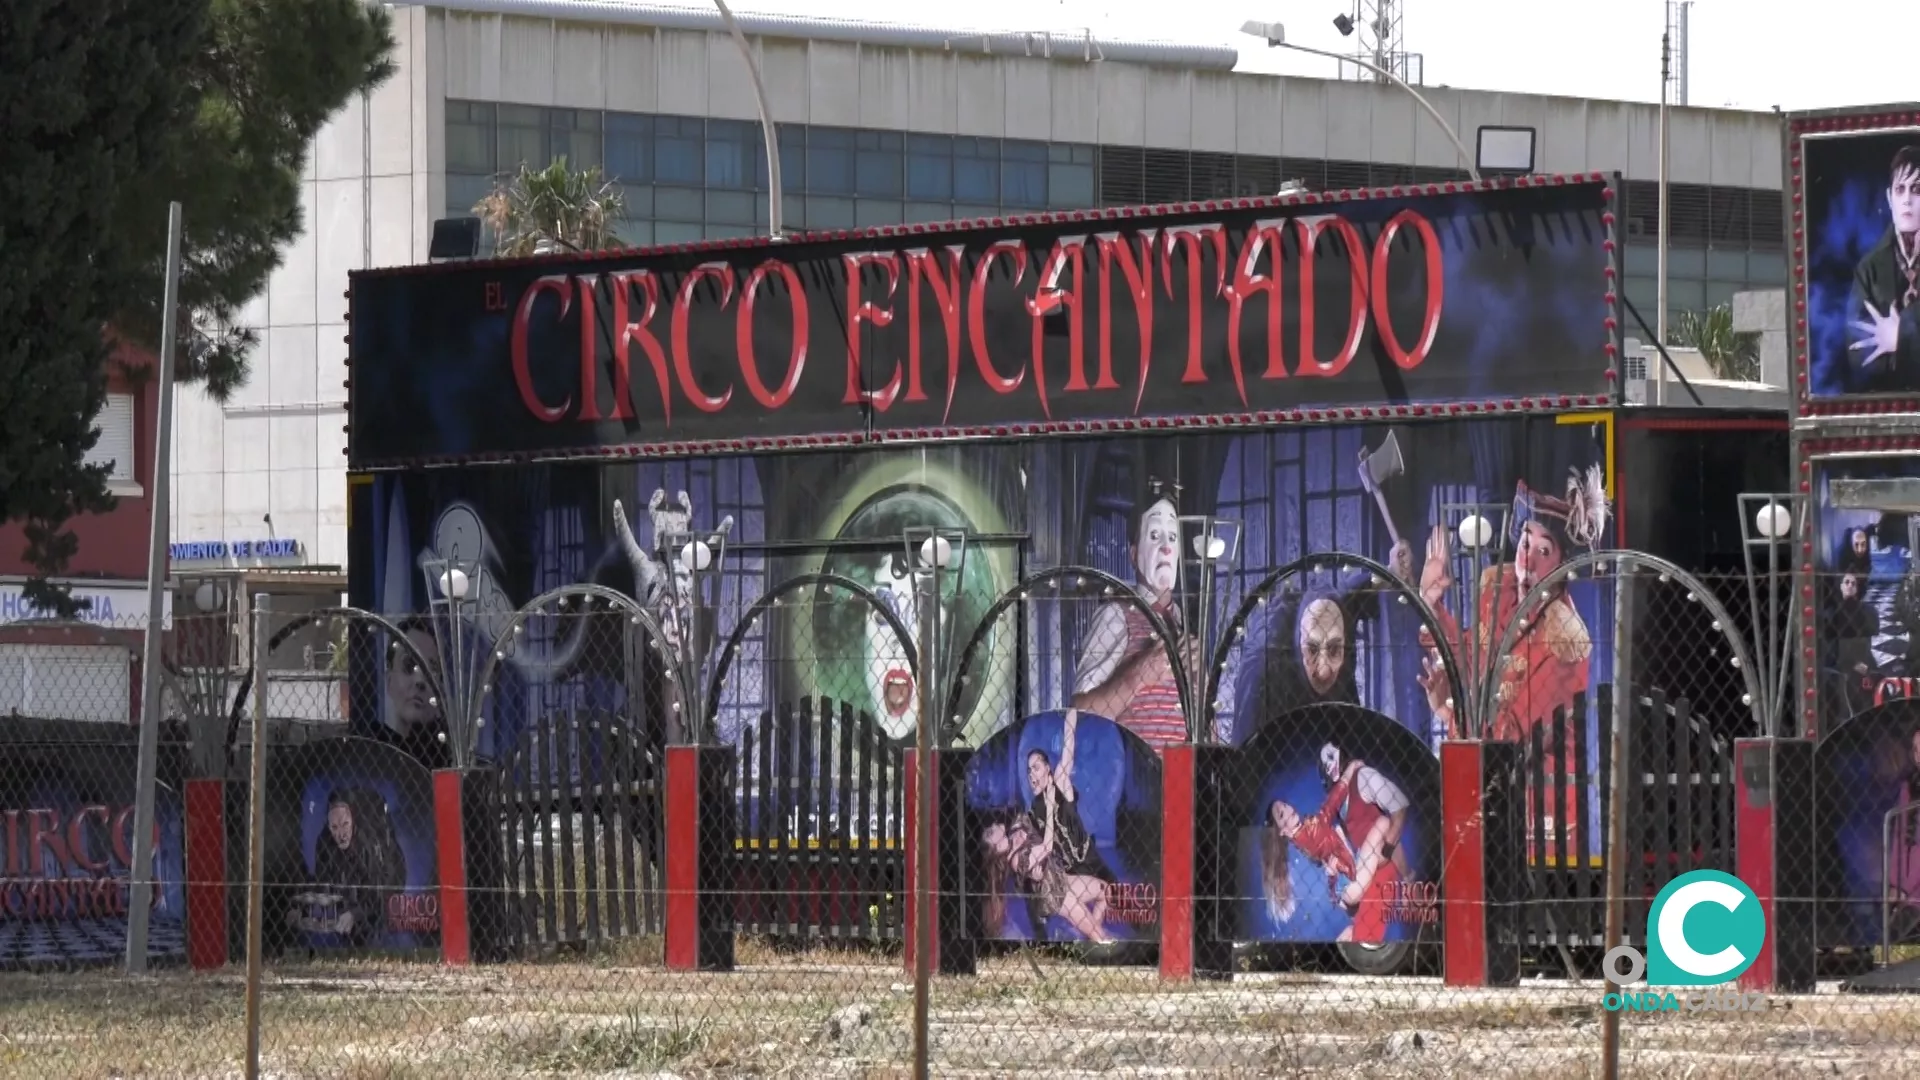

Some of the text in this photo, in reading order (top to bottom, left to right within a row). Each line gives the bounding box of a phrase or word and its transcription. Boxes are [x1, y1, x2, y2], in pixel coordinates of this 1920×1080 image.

[485, 208, 1444, 430] EL CIRCO ENCANTADO
[0, 805, 160, 877] IRCO
[387, 893, 438, 916] CIRCO
[1105, 883, 1157, 908] CIRCO
[1381, 881, 1438, 907] CIRCO
